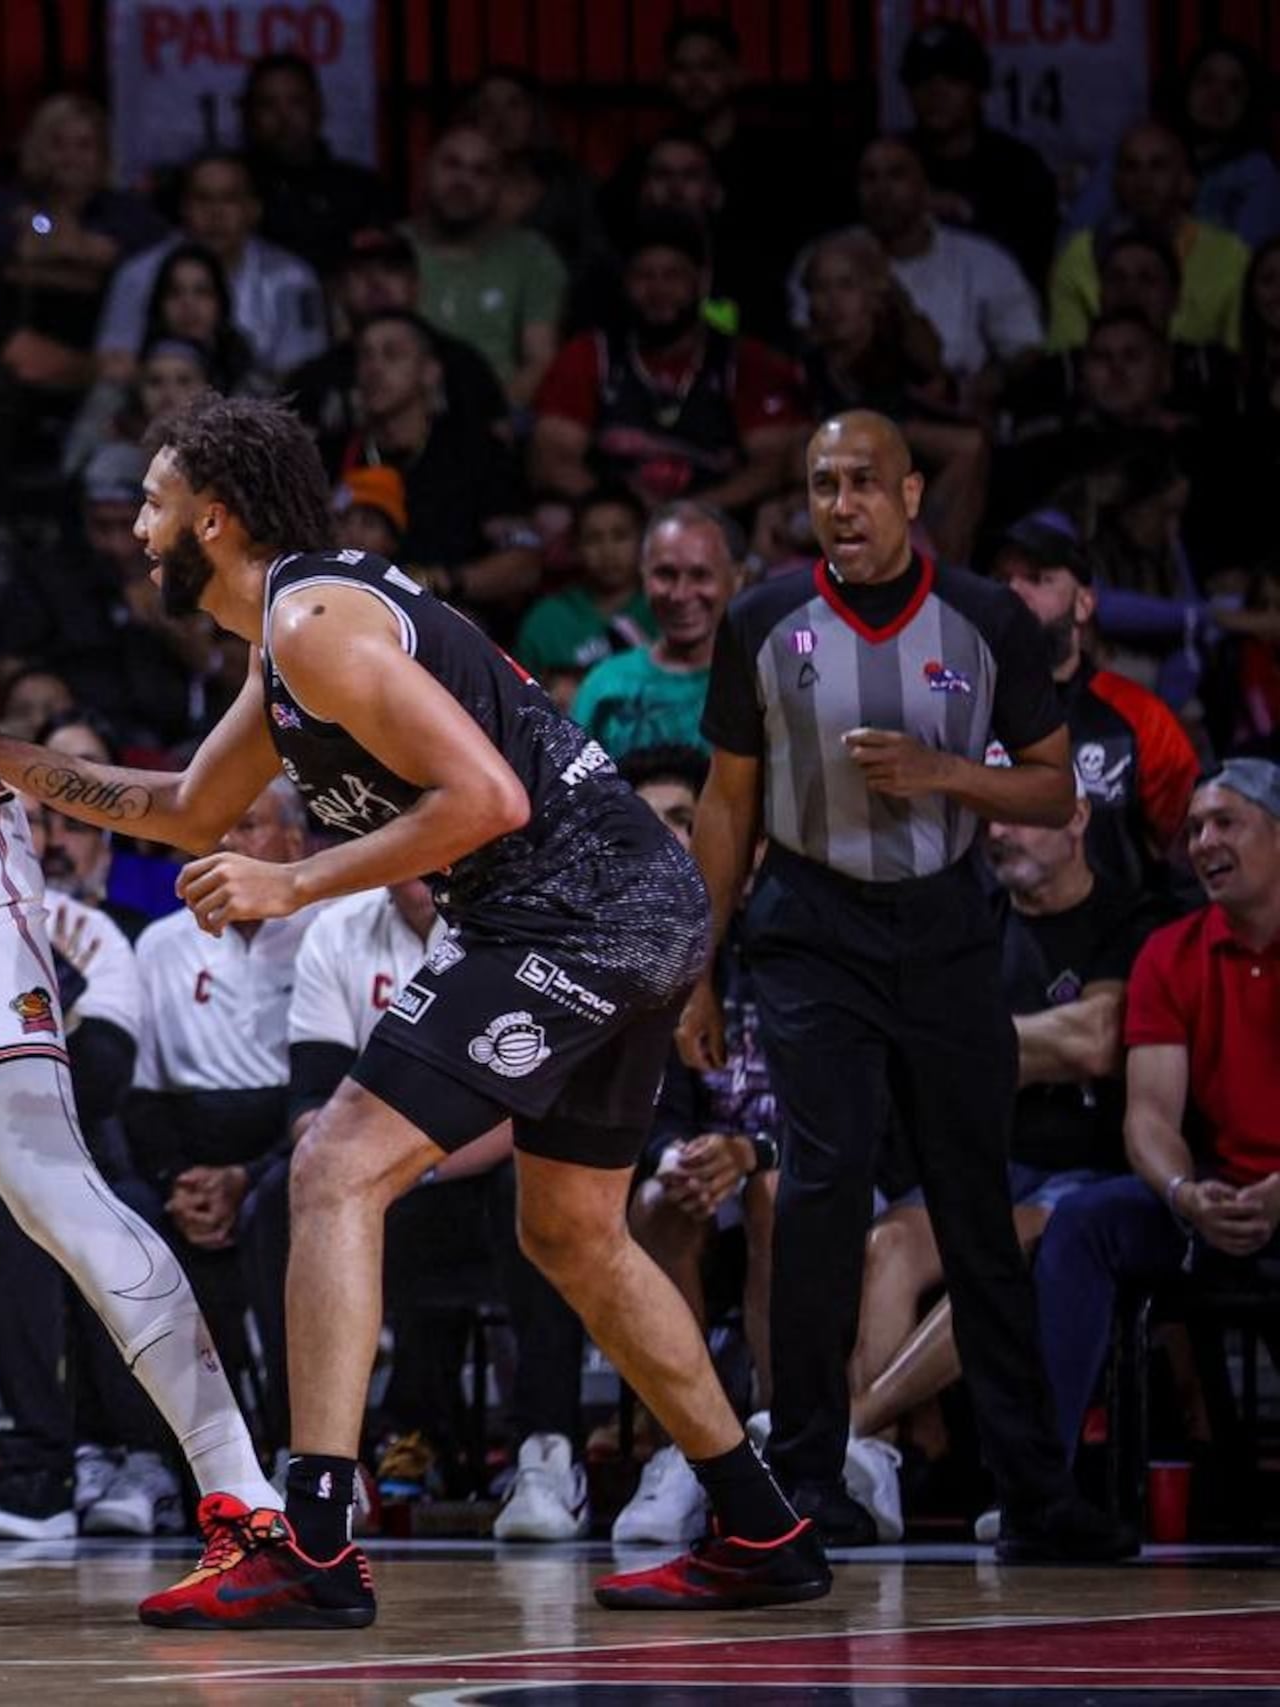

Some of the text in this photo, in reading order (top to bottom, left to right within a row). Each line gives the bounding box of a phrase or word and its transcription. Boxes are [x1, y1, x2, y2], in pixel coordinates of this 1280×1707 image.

[141, 4, 347, 74] PALCO
[1005, 65, 1063, 126] 14
[194, 969, 213, 1005] C
[372, 972, 393, 1012] C
